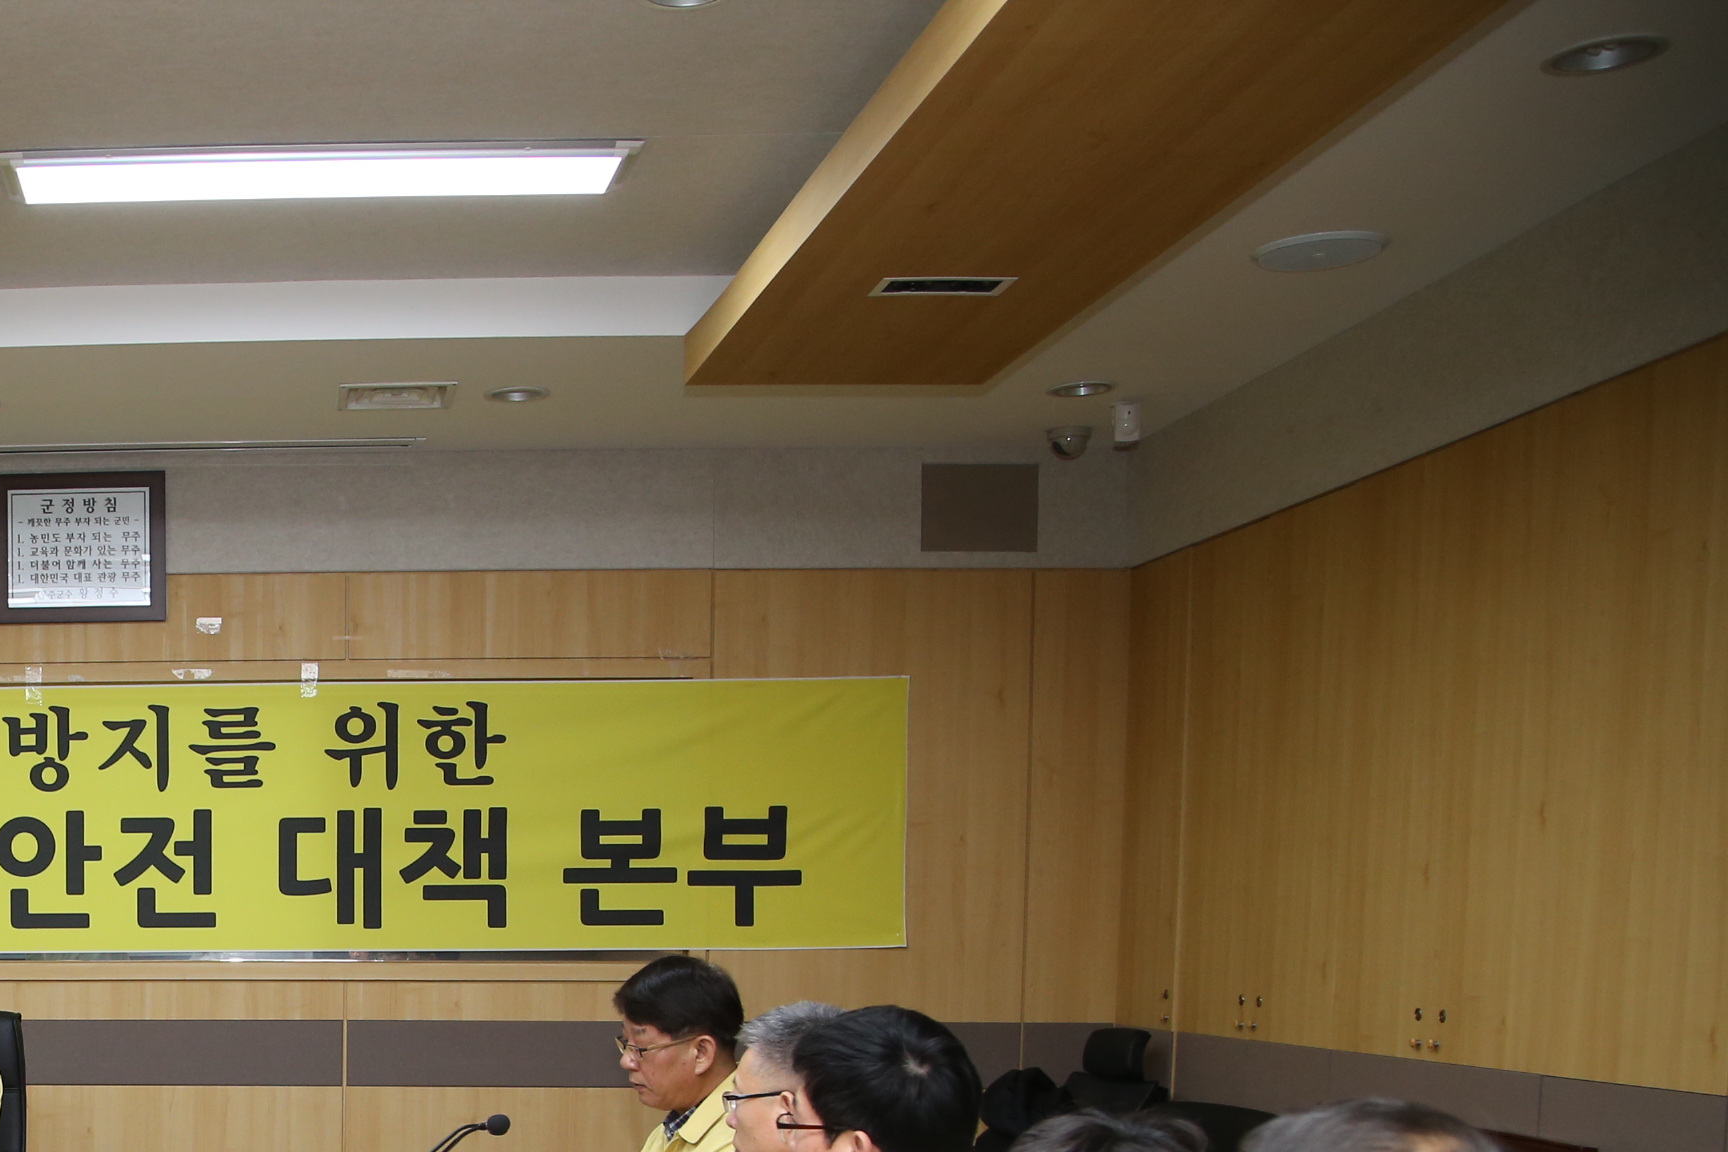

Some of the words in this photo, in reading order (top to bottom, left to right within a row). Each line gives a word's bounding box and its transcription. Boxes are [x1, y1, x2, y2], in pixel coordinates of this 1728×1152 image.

[40, 497, 117, 514] 군정방침
[54, 517, 72, 527] 무주
[74, 517, 91, 526] 부자
[94, 516, 110, 526] 되는
[113, 516, 131, 526] 군민
[17, 534, 25, 544] 1.
[29, 533, 61, 544] 농민도
[65, 532, 86, 543] 부자
[92, 532, 113, 542] 되는
[121, 531, 141, 542] 무주
[17, 547, 25, 557] 1.
[29, 546, 59, 557] 교육과
[64, 546, 93, 557] 문화가
[97, 545, 117, 556] 있는
[120, 544, 141, 556] 무주
[17, 561, 25, 571] 1.
[30, 560, 61, 571] 더불어
[65, 559, 86, 570] 함께
[92, 559, 113, 570] 사는
[120, 558, 141, 569] 무주
[17, 574, 25, 584] 1.
[30, 573, 68, 584] 대한민국
[73, 573, 93, 583] 대표
[97, 572, 117, 583] 관광
[121, 571, 141, 582] 무주
[2, 705, 276, 792] 방지를
[324, 701, 506, 790] 위한
[279, 807, 507, 929] 대책
[563, 806, 802, 926] 본부
